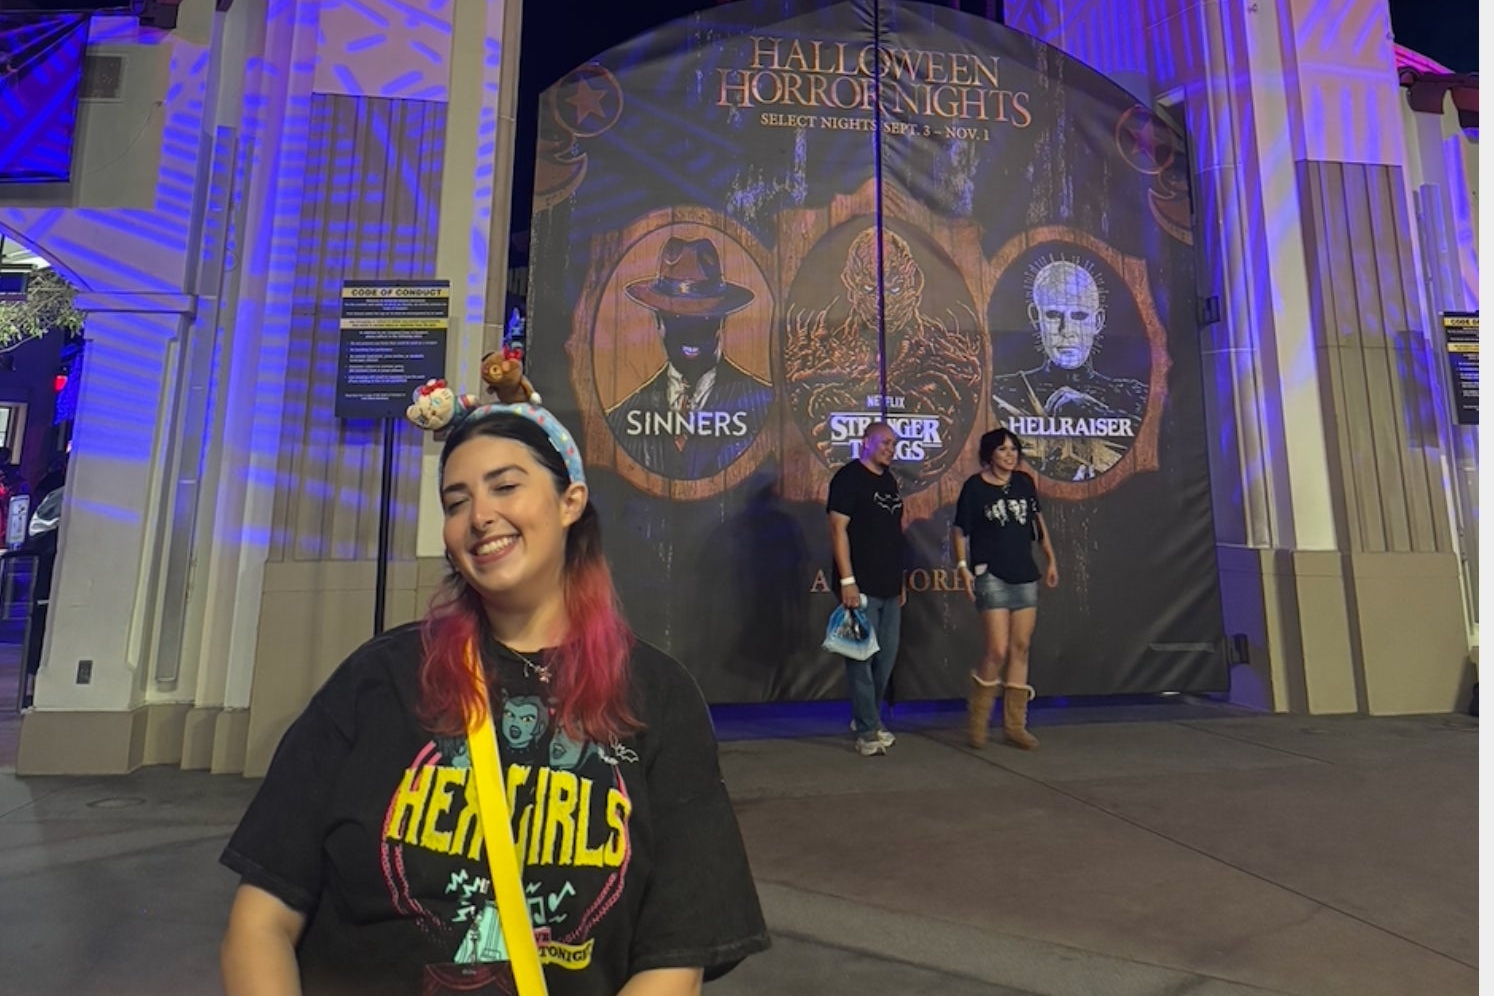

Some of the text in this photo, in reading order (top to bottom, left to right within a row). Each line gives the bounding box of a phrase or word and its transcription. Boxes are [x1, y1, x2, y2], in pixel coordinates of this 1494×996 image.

[749, 35, 1001, 89] HALLOWEEN
[886, 79, 1033, 129] NIGHTS
[760, 112, 818, 129] SELECT
[819, 116, 878, 132] NIGHTS
[883, 121, 921, 137] SEPT.
[922, 124, 932, 137] 3
[944, 126, 981, 141] NOV.
[983, 129, 990, 141] 1
[351, 288, 443, 297] CODE OF CONDUCT
[866, 395, 905, 408] NEFLIX
[626, 409, 748, 437] SINNERS
[830, 415, 942, 443] STRNGER
[1008, 416, 1134, 437] HELLRAISER
